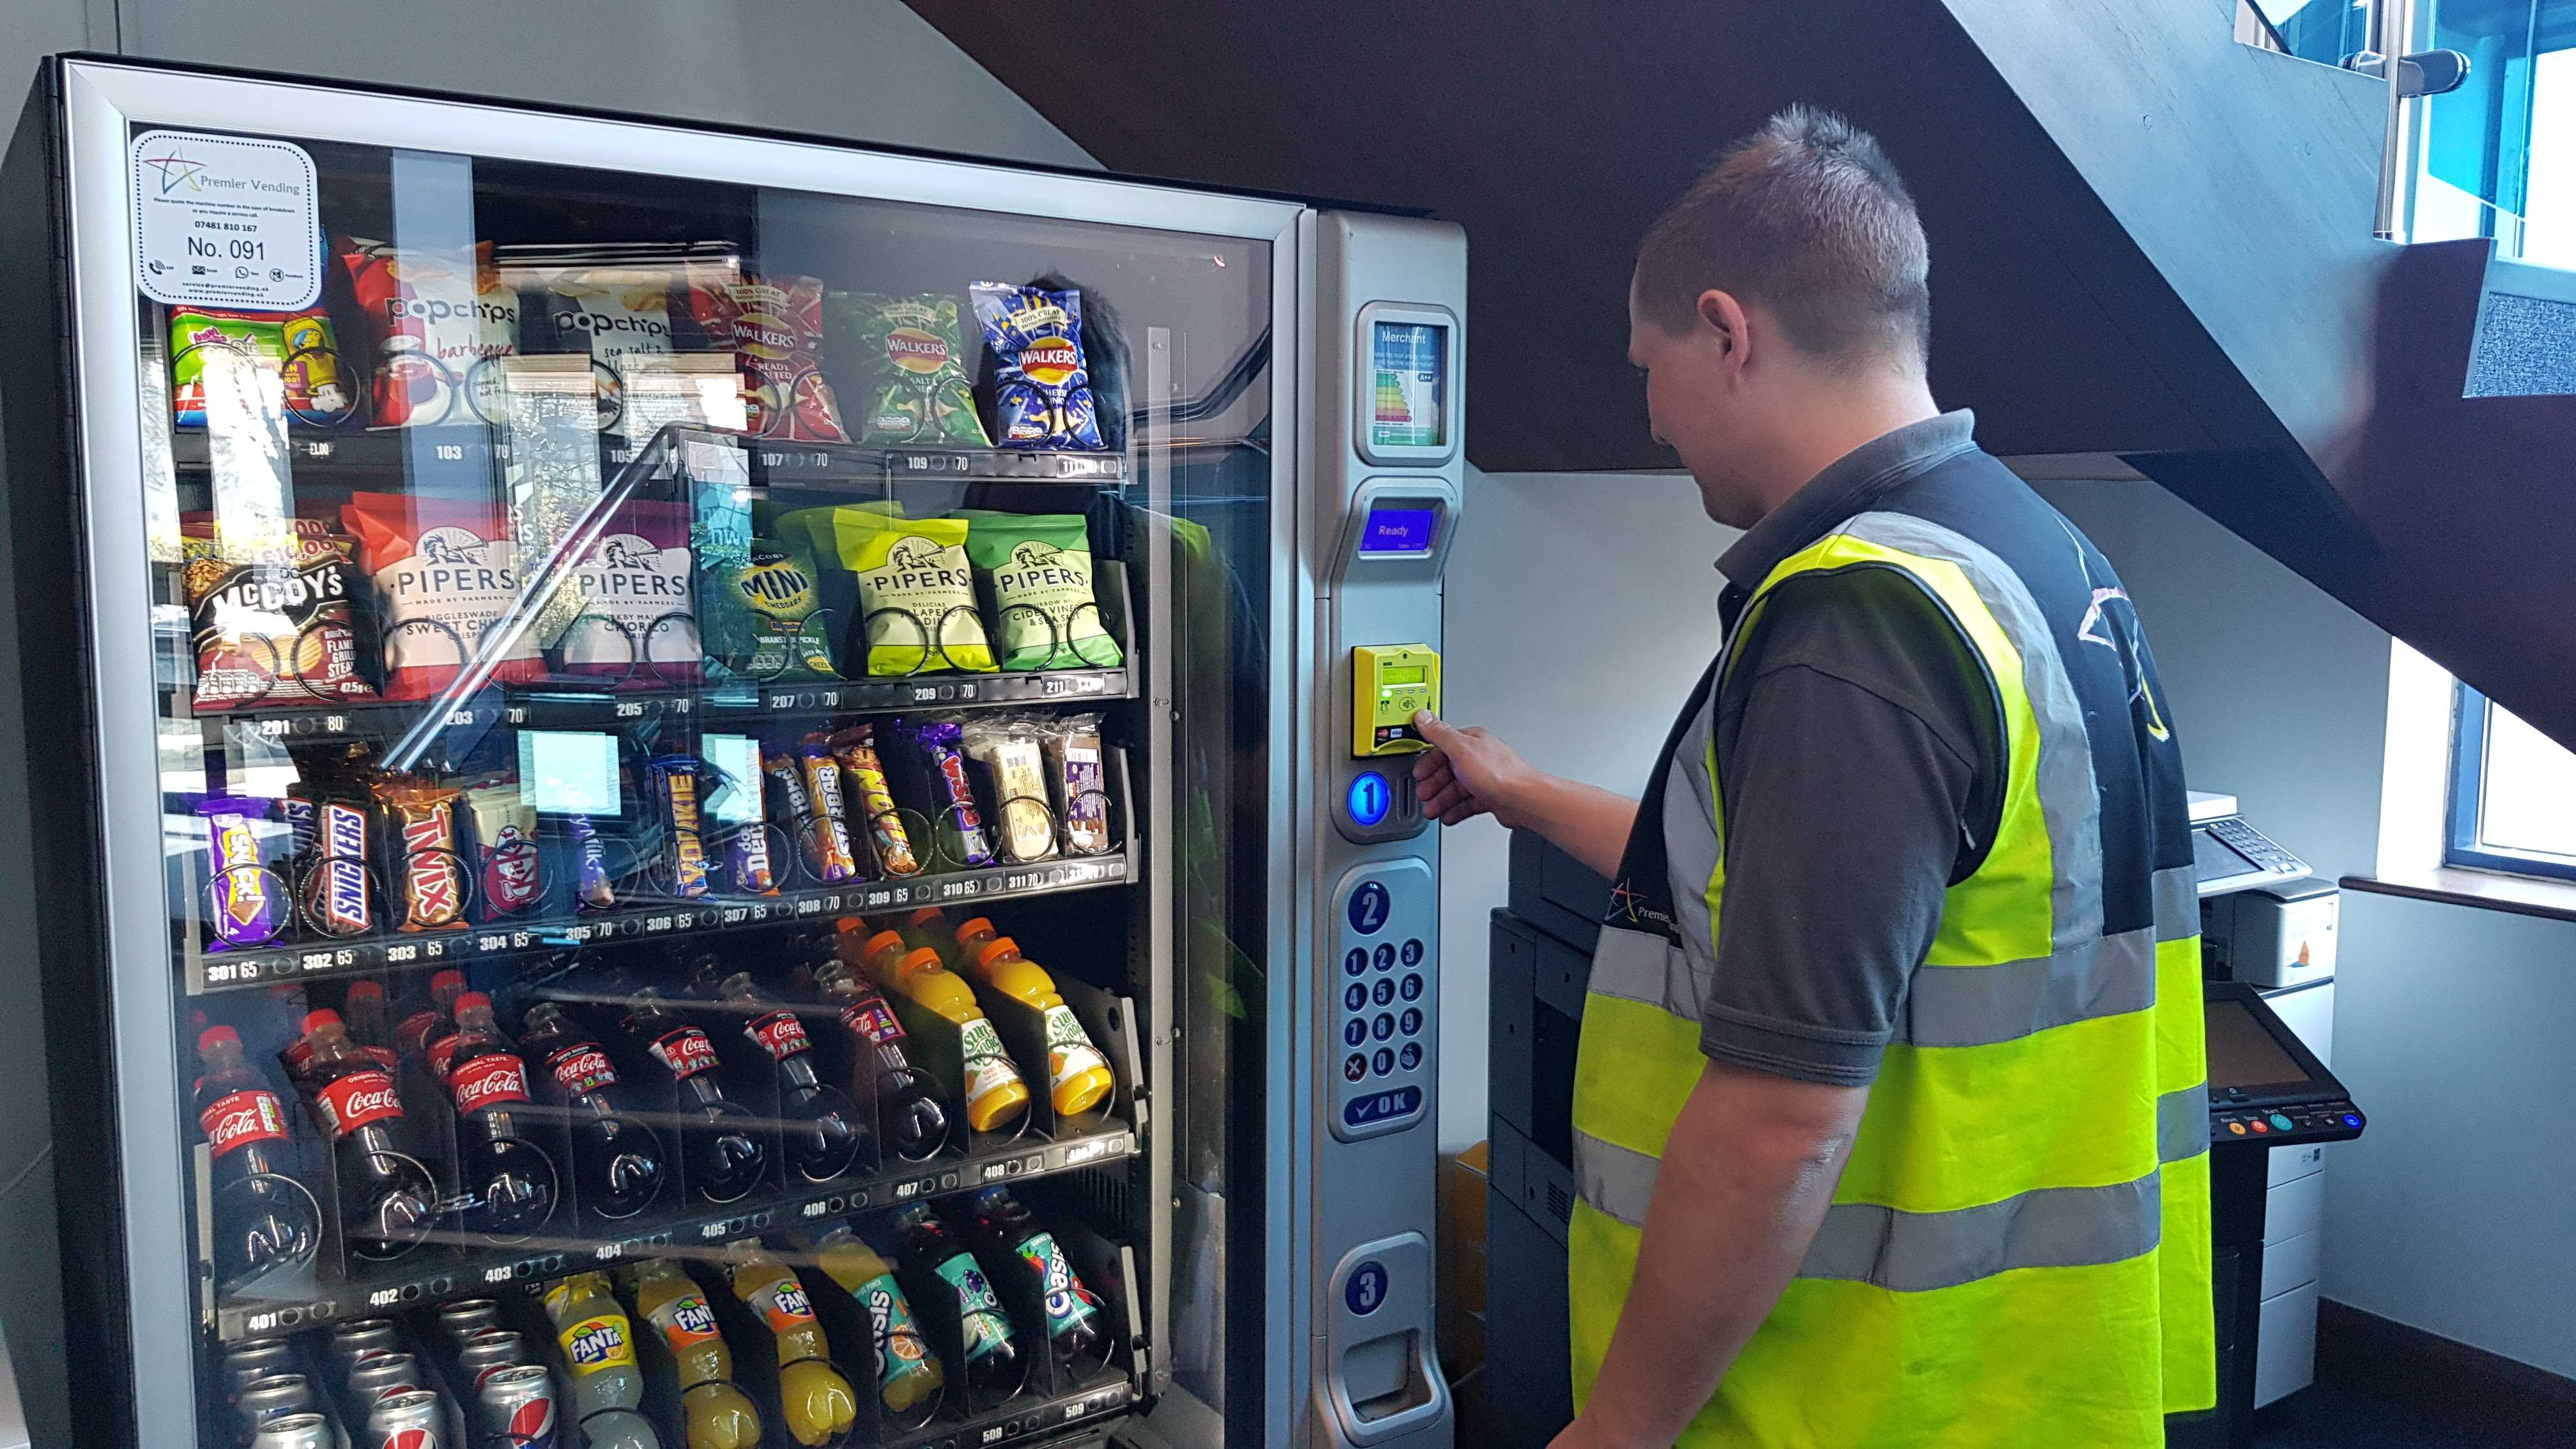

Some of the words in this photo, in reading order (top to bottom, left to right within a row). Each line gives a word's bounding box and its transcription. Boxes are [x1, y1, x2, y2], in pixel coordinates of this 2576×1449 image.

[200, 175, 247, 190] Premier
[250, 180, 300, 195] Vending
[194, 221, 220, 229] 07481
[188, 236, 222, 257] No.
[230, 240, 264, 260] 091
[385, 297, 515, 326] popchips
[1022, 314, 1038, 323] 100%
[1038, 309, 1060, 320] GREAT
[733, 325, 795, 348] WALKERS
[1382, 330, 1426, 344] Merchant
[886, 338, 946, 356] WALKERS
[1021, 349, 1076, 365] WALKERS
[758, 362, 790, 371] READY
[436, 445, 463, 459] 103
[496, 445, 509, 458] 70
[611, 450, 633, 463] 105
[762, 453, 783, 466] 107
[816, 453, 828, 466] 70
[908, 456, 927, 470] 109
[956, 456, 968, 471] 70
[1378, 525, 1409, 537] Ready
[397, 568, 516, 595] PIPERS
[579, 574, 686, 596] PIPERS
[740, 568, 809, 601] MINI
[873, 568, 968, 590] PIPERS
[1000, 568, 1085, 592] PIPERS
[764, 595, 802, 610] CHEDDARS
[915, 687, 936, 700] 209
[962, 684, 975, 698] 70
[1046, 681, 1064, 693] 211
[617, 703, 643, 716] 205
[675, 699, 689, 713] 70
[772, 695, 795, 709] 207
[824, 693, 838, 706] 70
[447, 711, 473, 724] 203
[509, 708, 523, 723] 70
[262, 720, 290, 735] 201
[328, 716, 344, 731] 80
[1363, 781, 1374, 815] 1
[332, 808, 363, 925] SNICKERS
[944, 882, 962, 896] 310
[964, 880, 976, 893] 65
[1009, 875, 1027, 888] 311
[1027, 873, 1038, 887] 70
[798, 900, 821, 913] 308
[829, 896, 840, 909] 70
[869, 891, 891, 905] 309
[896, 888, 908, 902] 65
[724, 908, 748, 921] 307
[754, 904, 767, 918] 65
[1361, 891, 1379, 926] 2
[565, 926, 591, 940] 305
[599, 922, 613, 937] 70
[647, 917, 671, 931] 306
[678, 913, 692, 928] 65
[480, 936, 507, 951] 304
[514, 932, 529, 947] 65
[303, 953, 333, 969] 302
[337, 950, 353, 965] 65
[388, 946, 416, 961] 303
[427, 941, 442, 956] 65
[1349, 952, 1358, 972] 1
[1377, 948, 1387, 967] 2
[1405, 943, 1414, 962] 3
[208, 966, 237, 981] 301
[241, 962, 257, 977] 65
[1348, 987, 1358, 1006] 4
[1377, 983, 1386, 1003] 5
[1404, 977, 1414, 997] 6
[1052, 1011, 1076, 1036] Sun
[1350, 1023, 1358, 1041] 7
[1377, 1017, 1386, 1038] 8
[1404, 1012, 1414, 1031] 9
[964, 1025, 988, 1054] Sun
[456, 1060, 486, 1076] ORIGINAL
[555, 1052, 606, 1085] Coca-Cola
[1377, 1052, 1386, 1072] 0
[456, 1070, 521, 1111] Coca-Cola
[217, 1096, 240, 1108] TASTE
[1378, 1092, 1406, 1114] OK
[984, 1163, 1005, 1177] 408
[896, 1182, 918, 1197] 407
[804, 1201, 826, 1216] 406
[702, 1223, 726, 1238] 405
[595, 1244, 622, 1261] 404
[484, 1266, 512, 1284] 403
[370, 1289, 398, 1306] 402
[1359, 1272, 1376, 1307] 3
[249, 1312, 277, 1330] 401
[570, 1326, 623, 1363] FANTA
[1065, 1402, 1085, 1418] 509
[983, 1427, 1003, 1443] 508
